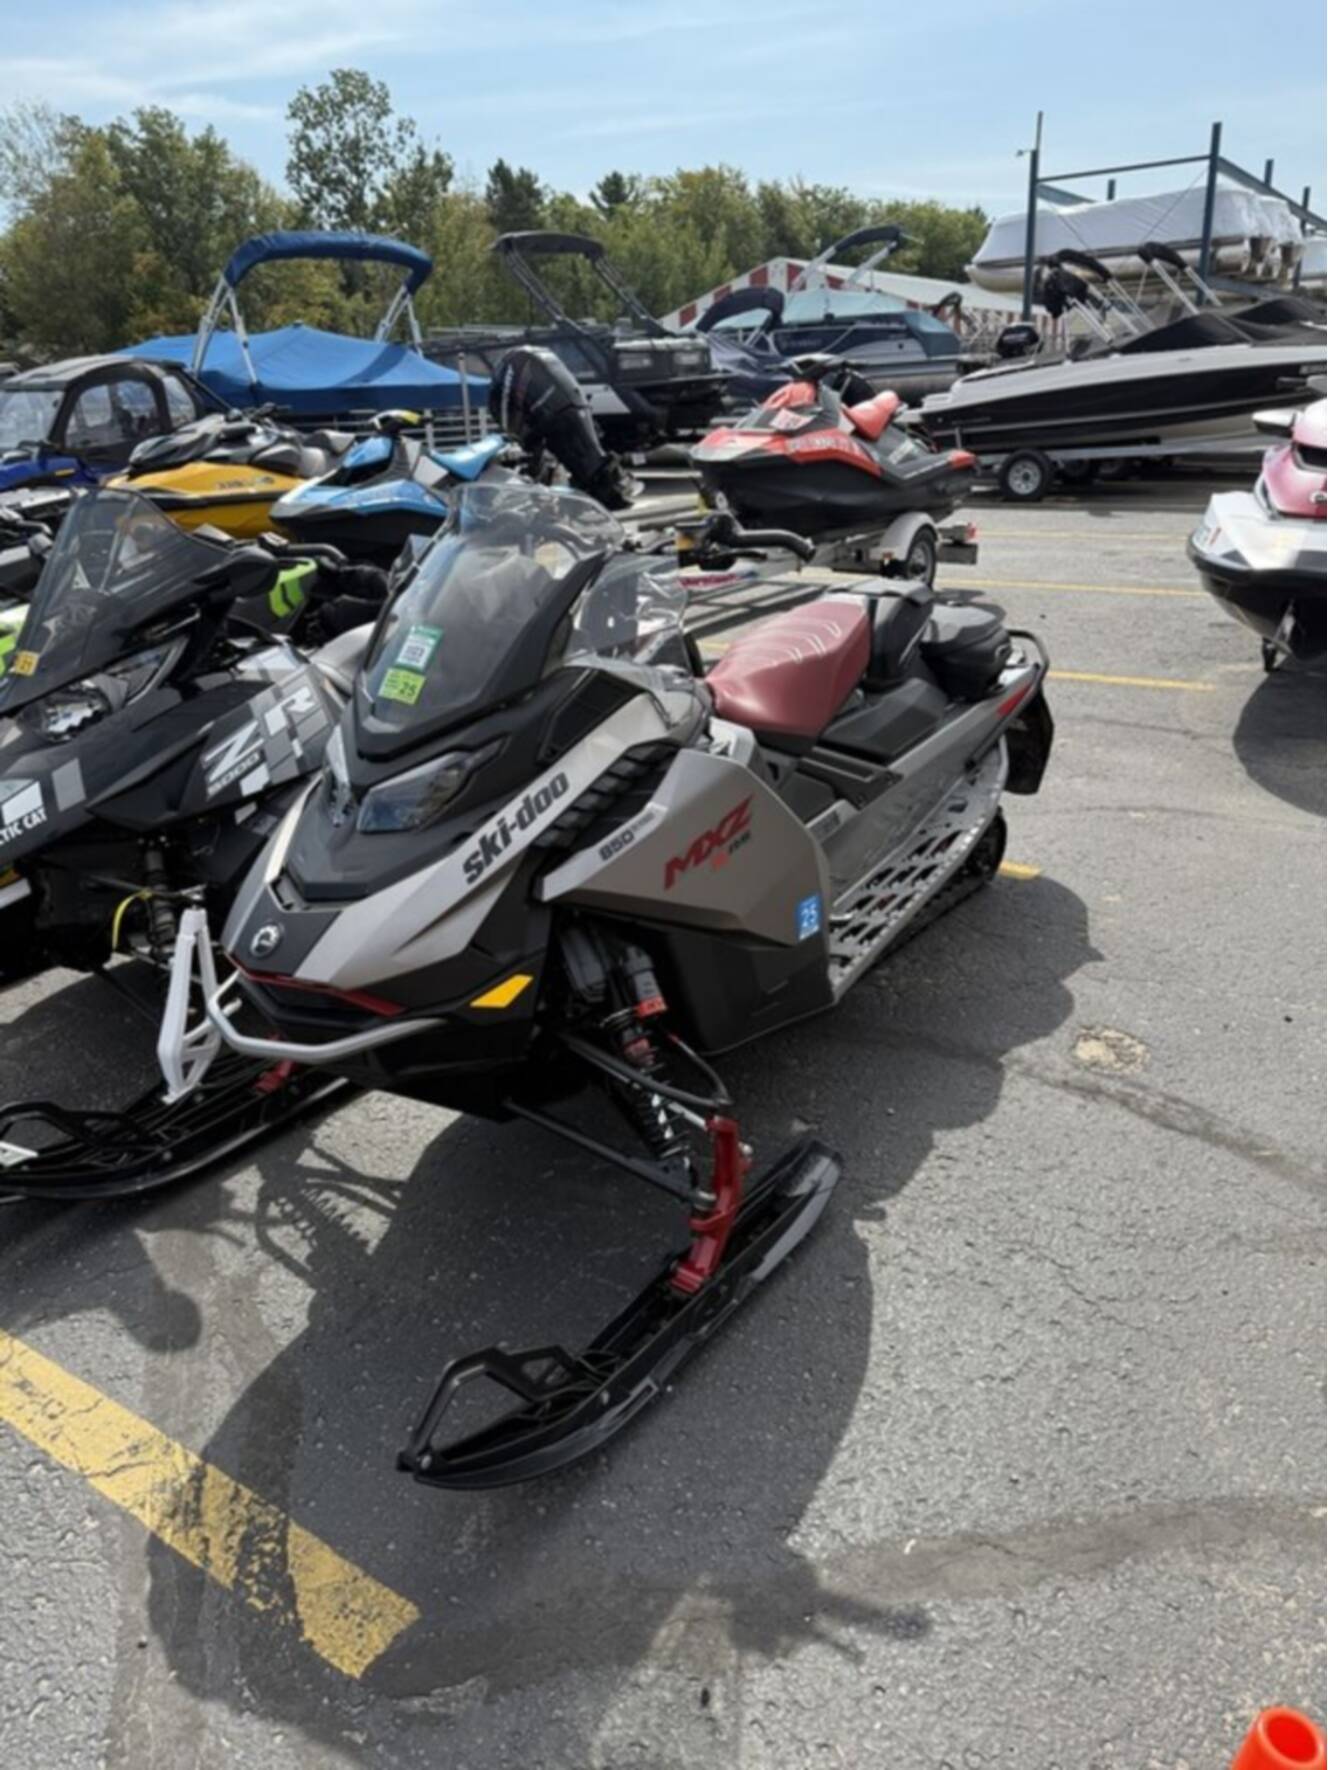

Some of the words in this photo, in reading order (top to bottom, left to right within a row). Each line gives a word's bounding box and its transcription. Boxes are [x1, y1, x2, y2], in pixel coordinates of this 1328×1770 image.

[204, 686, 316, 783] ZR
[22, 807, 48, 829] CAT
[600, 830, 635, 862] 850
[664, 794, 753, 891] MXZ
